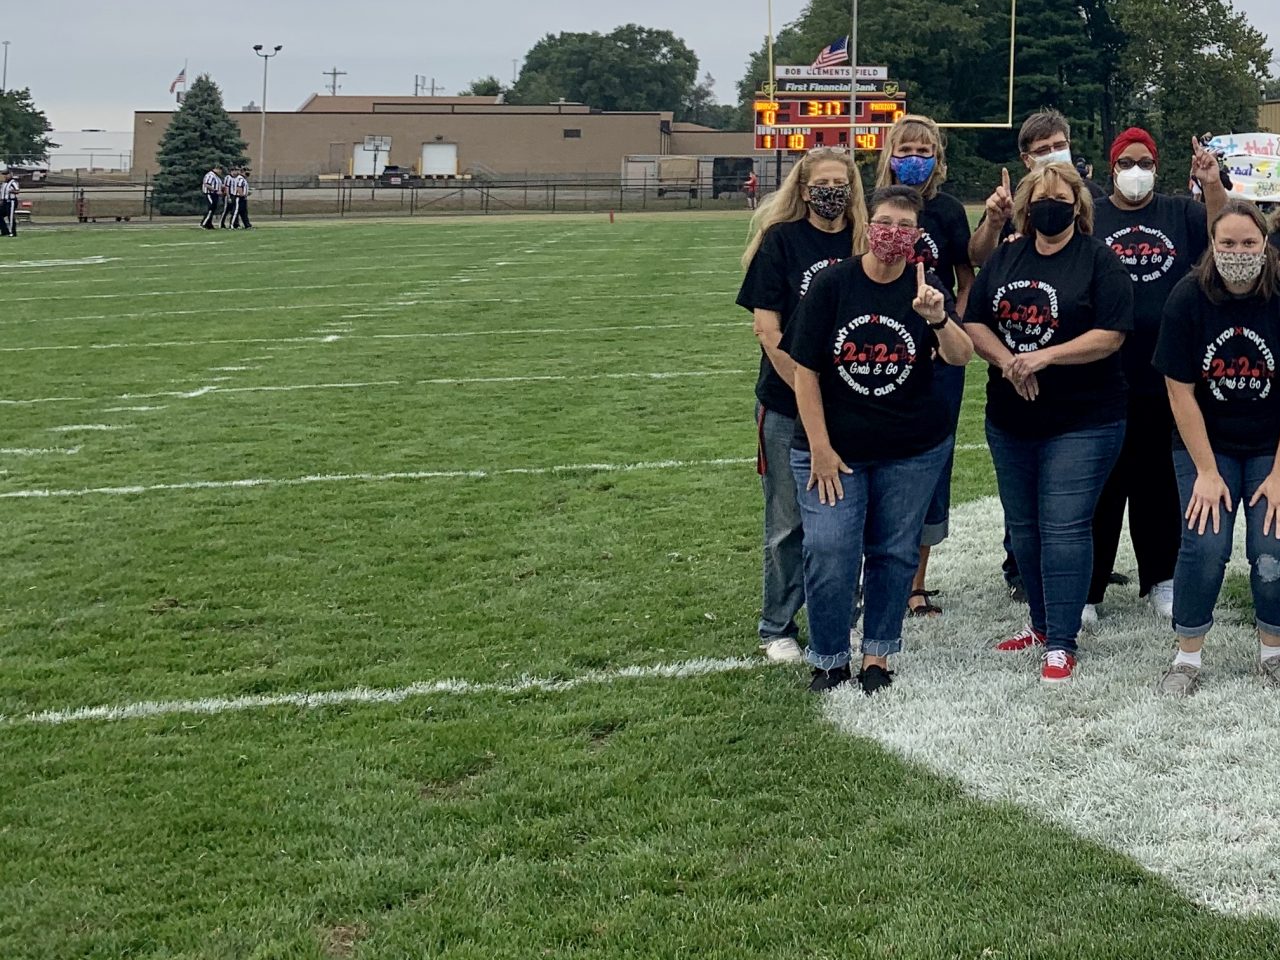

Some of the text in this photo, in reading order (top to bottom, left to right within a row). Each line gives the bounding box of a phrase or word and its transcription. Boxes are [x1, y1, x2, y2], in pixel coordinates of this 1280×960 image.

[785, 83, 807, 91] First
[809, 83, 851, 91] Financial
[808, 101, 841, 116] 3:17
[764, 110, 776, 125] 0
[788, 134, 804, 149] 10
[856, 134, 876, 149] 40
[1113, 227, 1131, 238] STOP
[1142, 270, 1161, 282] OUR
[1008, 280, 1031, 290] STOP
[848, 314, 871, 330] STOP
[902, 332, 916, 355] STOP
[1018, 342, 1038, 352] OUR
[1216, 327, 1234, 346] STOP
[1262, 348, 1275, 371] STOP
[849, 362, 898, 375] Grab & Go
[837, 364, 913, 396] FEEDING OUR KIDS
[1249, 377, 1261, 389] Go
